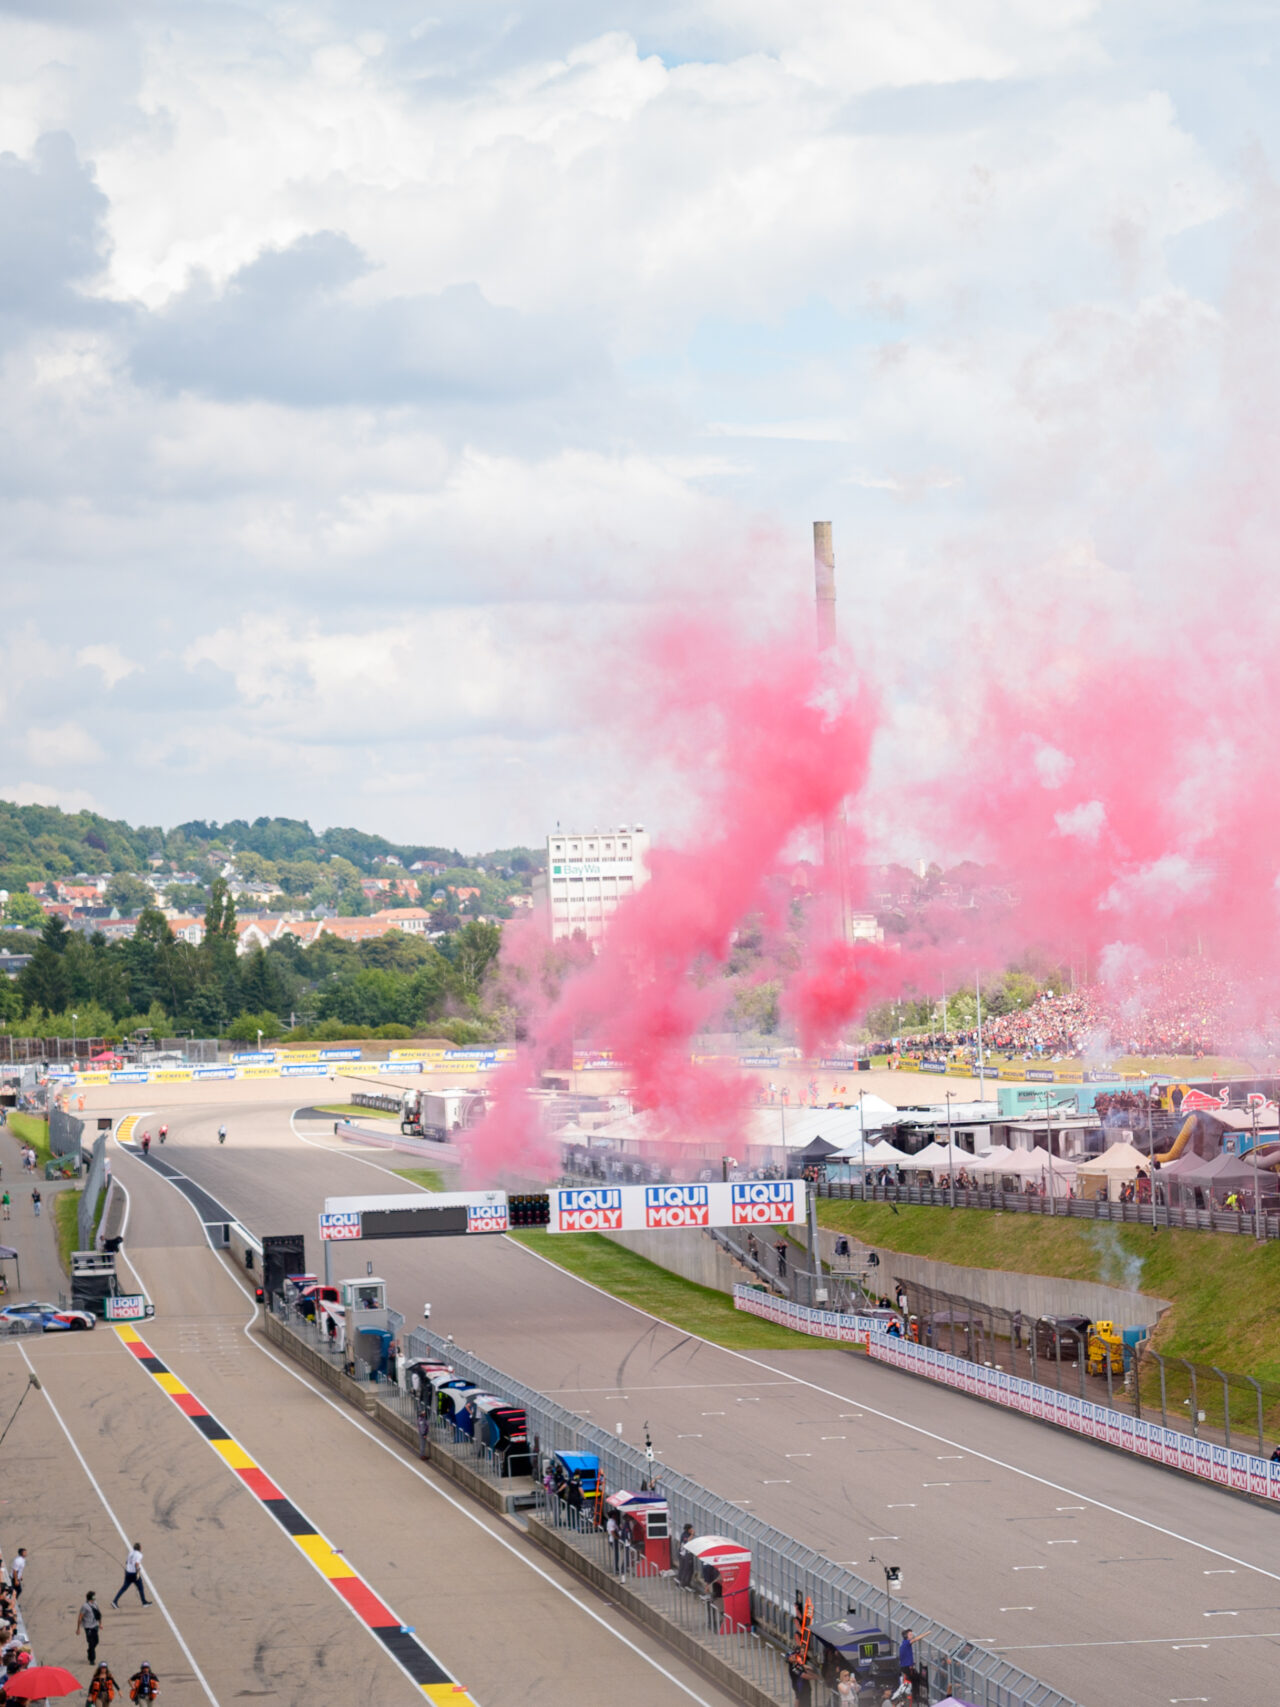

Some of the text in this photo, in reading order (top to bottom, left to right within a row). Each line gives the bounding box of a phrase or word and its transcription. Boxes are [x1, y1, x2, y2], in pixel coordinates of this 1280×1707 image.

[561, 1190, 619, 1211] LIQUI
[647, 1187, 706, 1208] LIQUI
[734, 1184, 791, 1205] LIQUI
[322, 1214, 358, 1226] LIQUI
[470, 1206, 505, 1219] LIQUI
[562, 1210, 621, 1230] MOLY
[649, 1206, 708, 1226] MOLY
[735, 1203, 793, 1223] MOLY
[322, 1226, 360, 1238] MOLY
[470, 1218, 507, 1231] MOLY
[114, 1298, 139, 1308] LIQUI
[113, 1307, 139, 1318] MOLY
